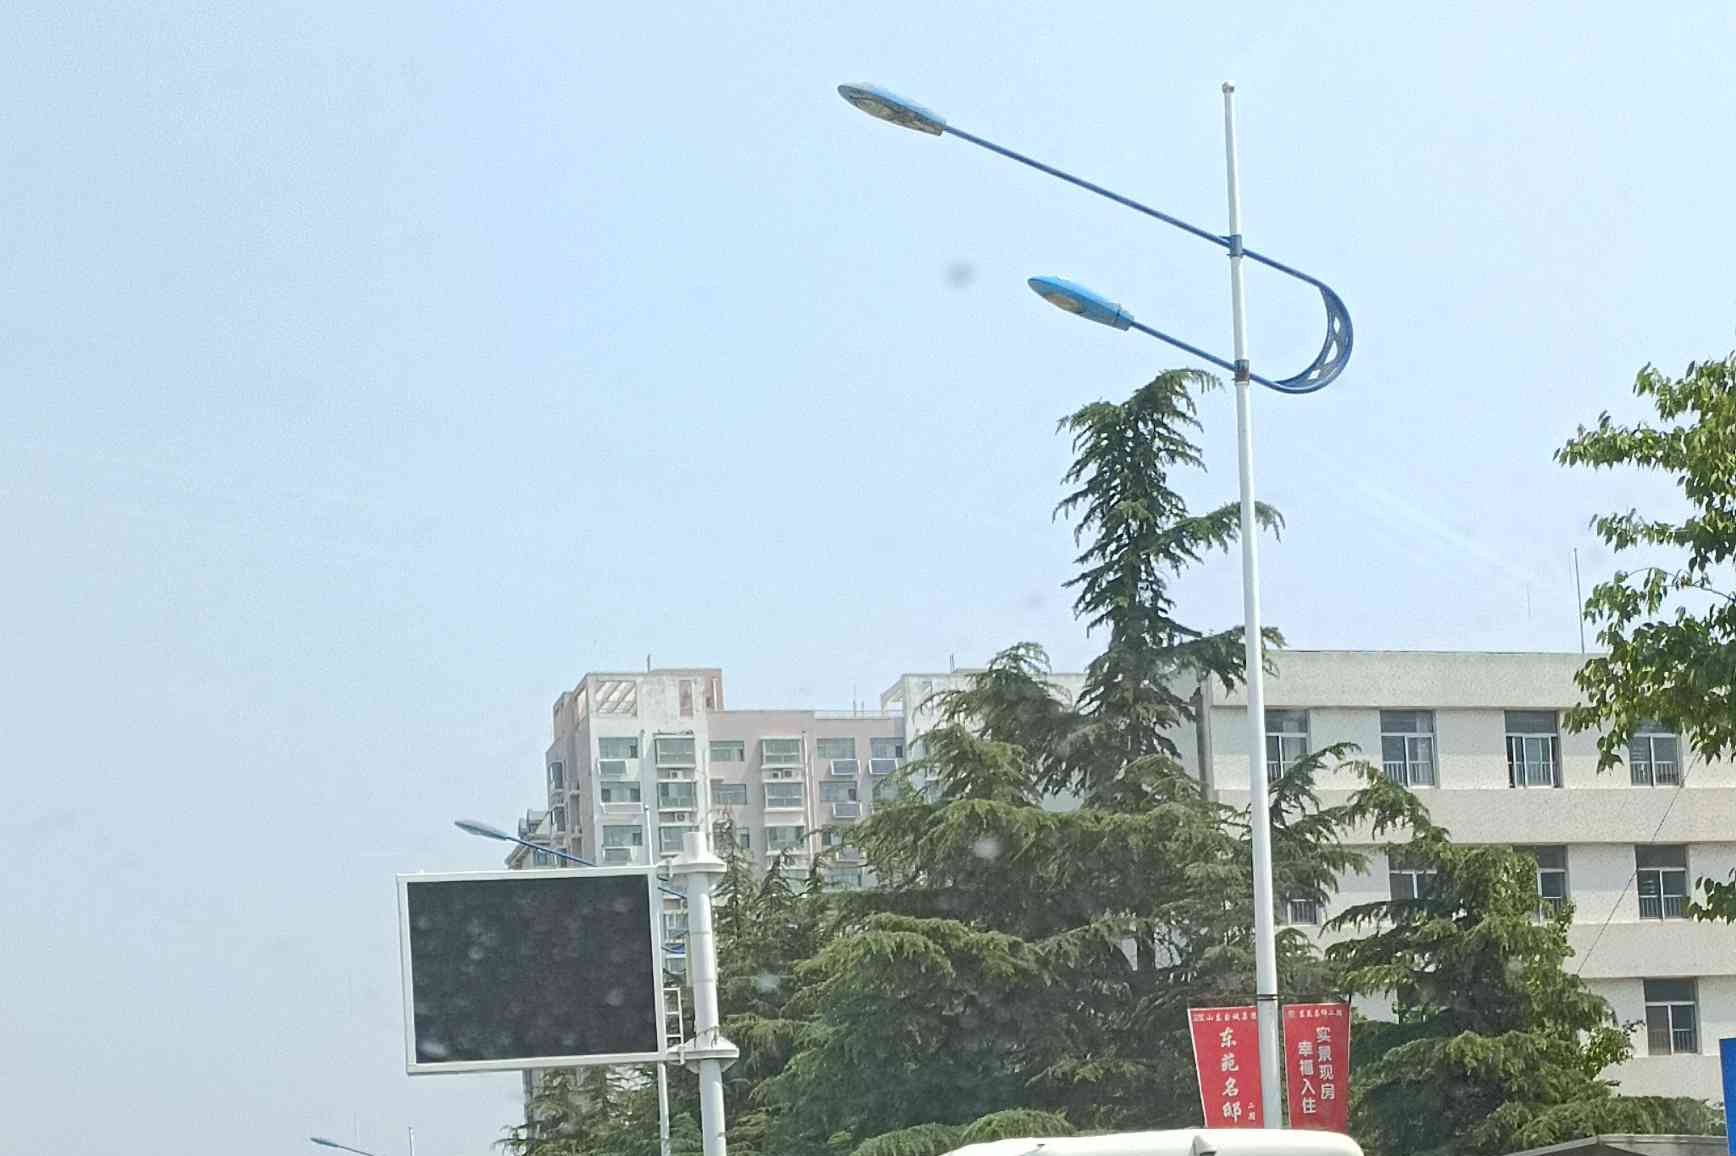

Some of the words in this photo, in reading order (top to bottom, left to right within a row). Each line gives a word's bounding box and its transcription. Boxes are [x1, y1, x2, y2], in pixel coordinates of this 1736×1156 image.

[1298, 1041, 1317, 1114] 幸福入住
[1316, 1026, 1336, 1100] 实景现房
